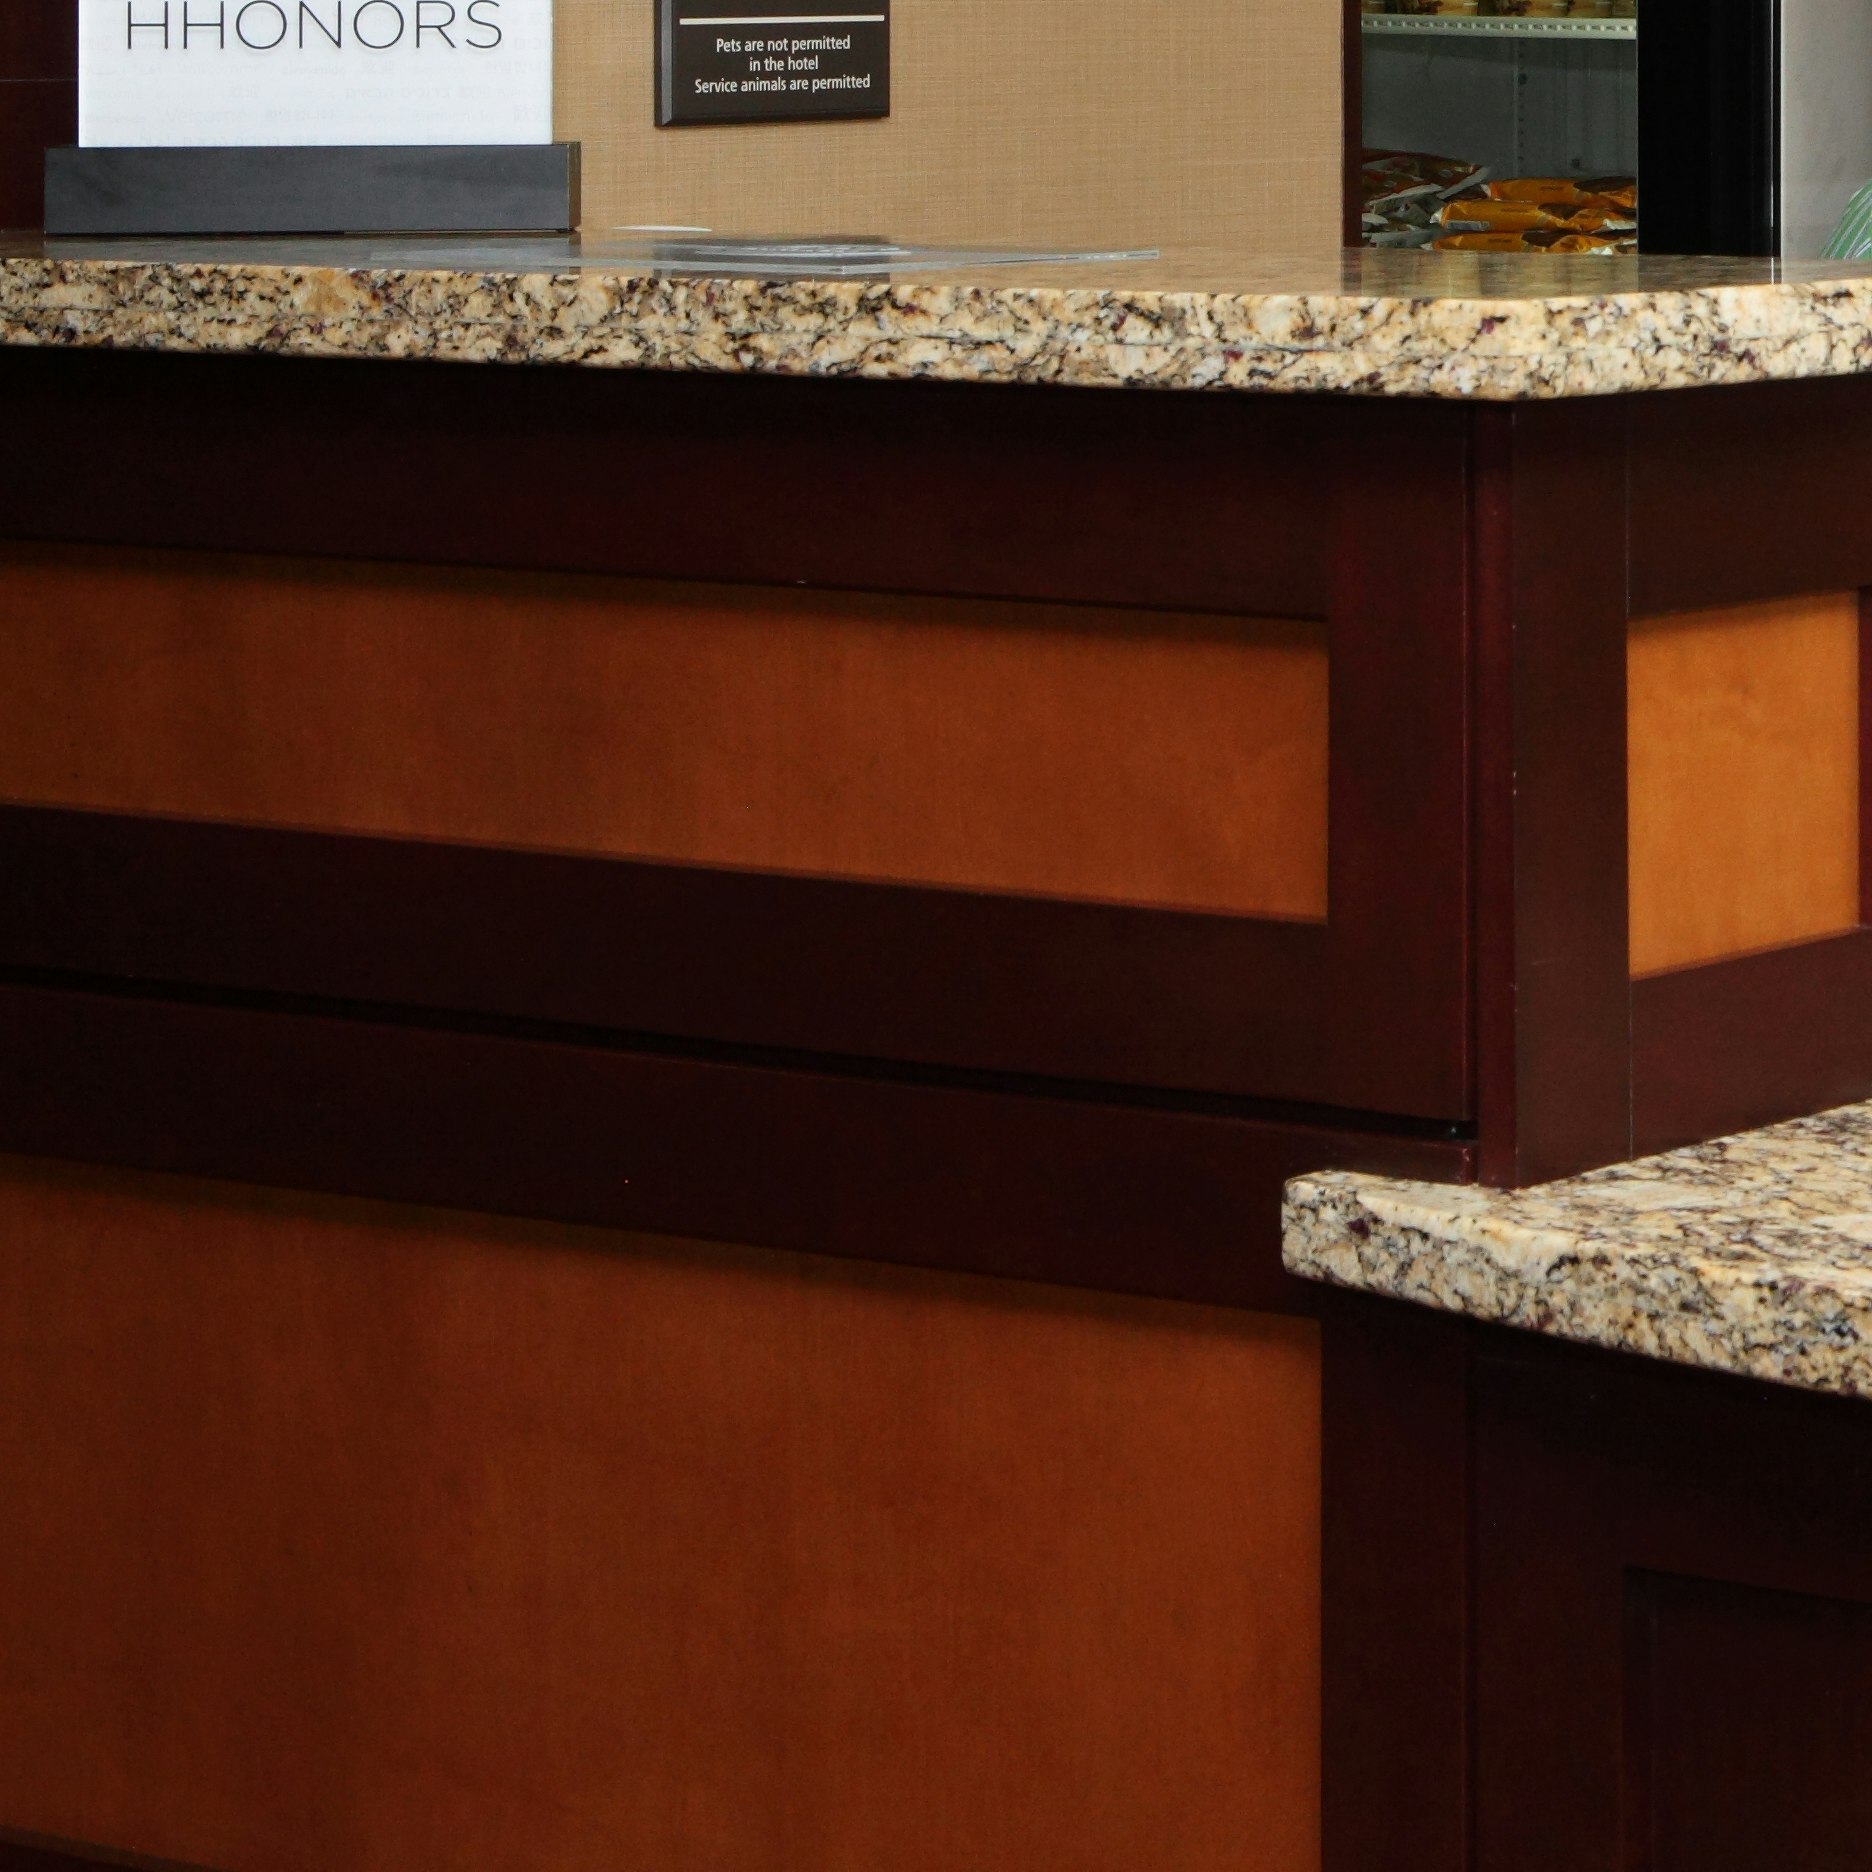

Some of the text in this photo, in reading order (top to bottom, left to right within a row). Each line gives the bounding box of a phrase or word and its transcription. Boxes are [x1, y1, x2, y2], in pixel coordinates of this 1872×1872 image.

[716, 34, 851, 53] Pets are not permitted
[749, 55, 819, 72] in the hotel
[695, 73, 871, 93] Service animals are permitted
